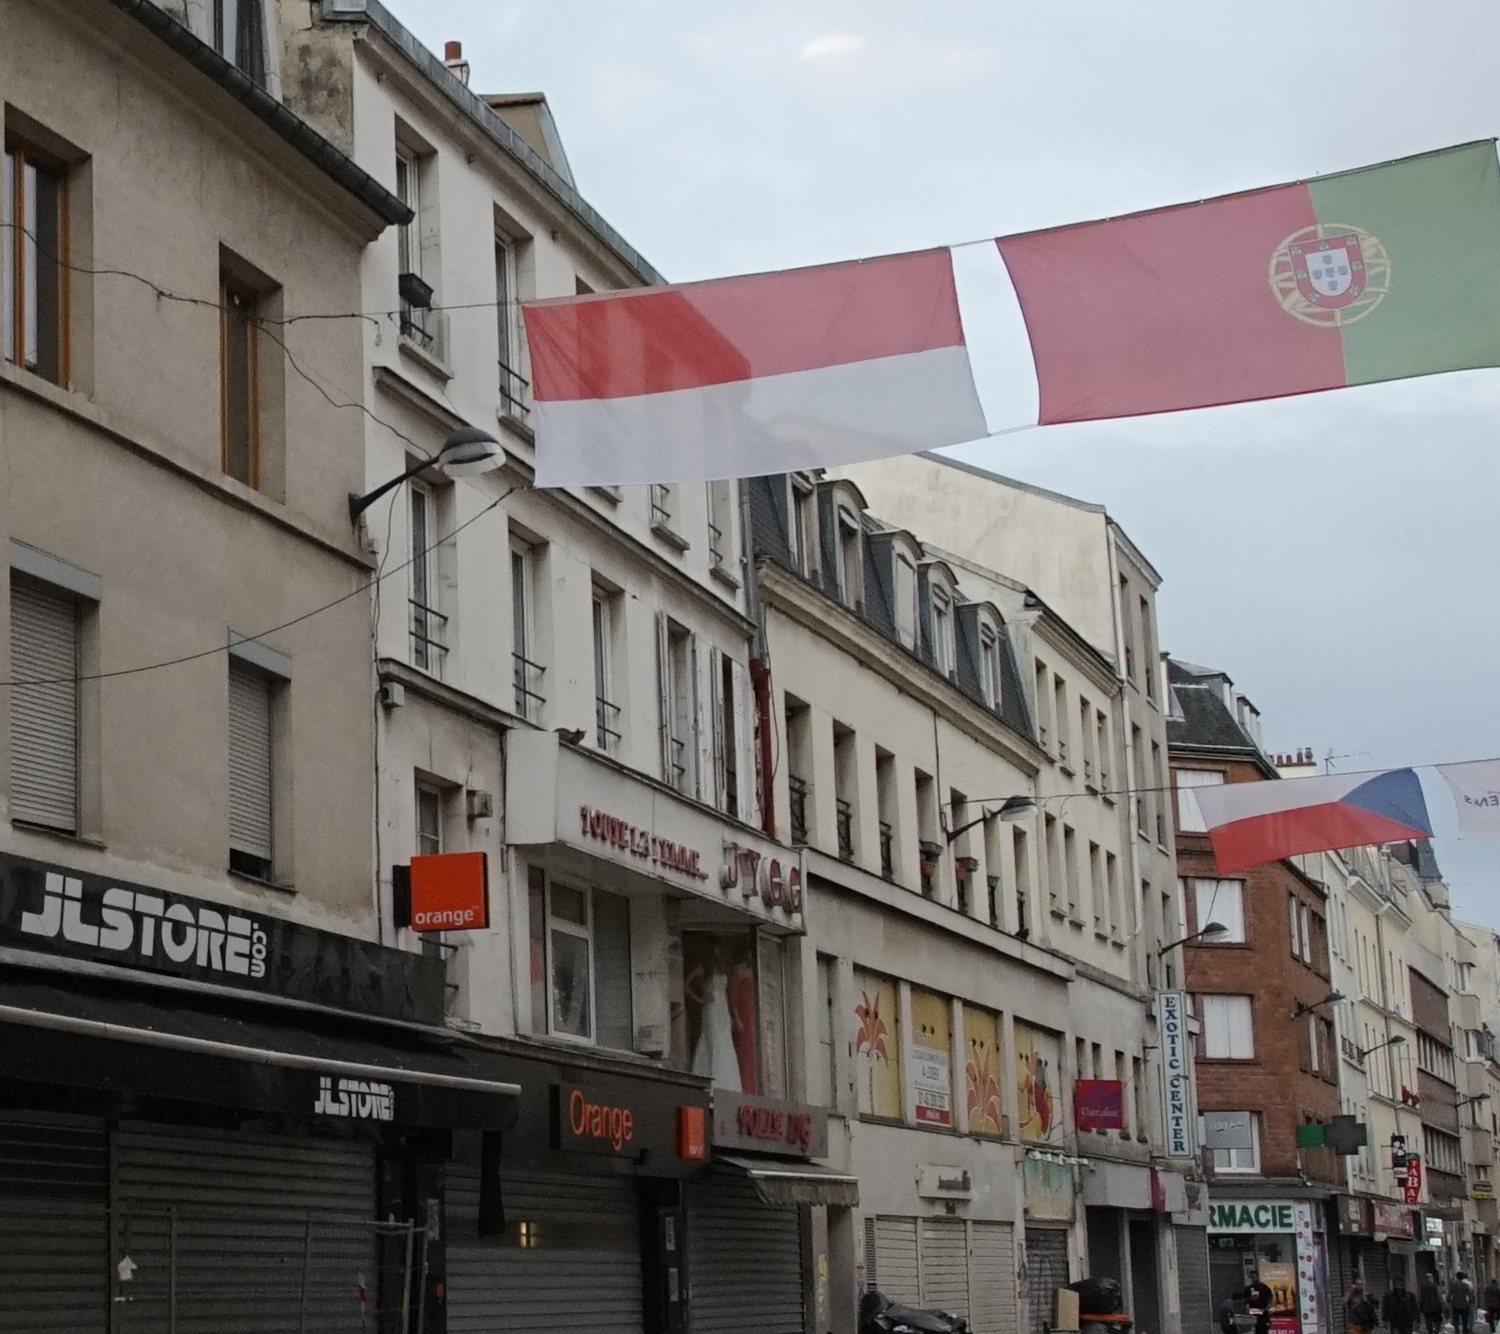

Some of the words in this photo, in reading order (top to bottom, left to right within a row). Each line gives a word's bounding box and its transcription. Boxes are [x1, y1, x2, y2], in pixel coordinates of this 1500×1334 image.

[415, 909, 474, 926] orange
[1164, 997, 1179, 1069] EXOTIC
[569, 1090, 633, 1150] Orange
[1169, 1078, 1185, 1152] CENTER
[1407, 1160, 1419, 1203] TABAC
